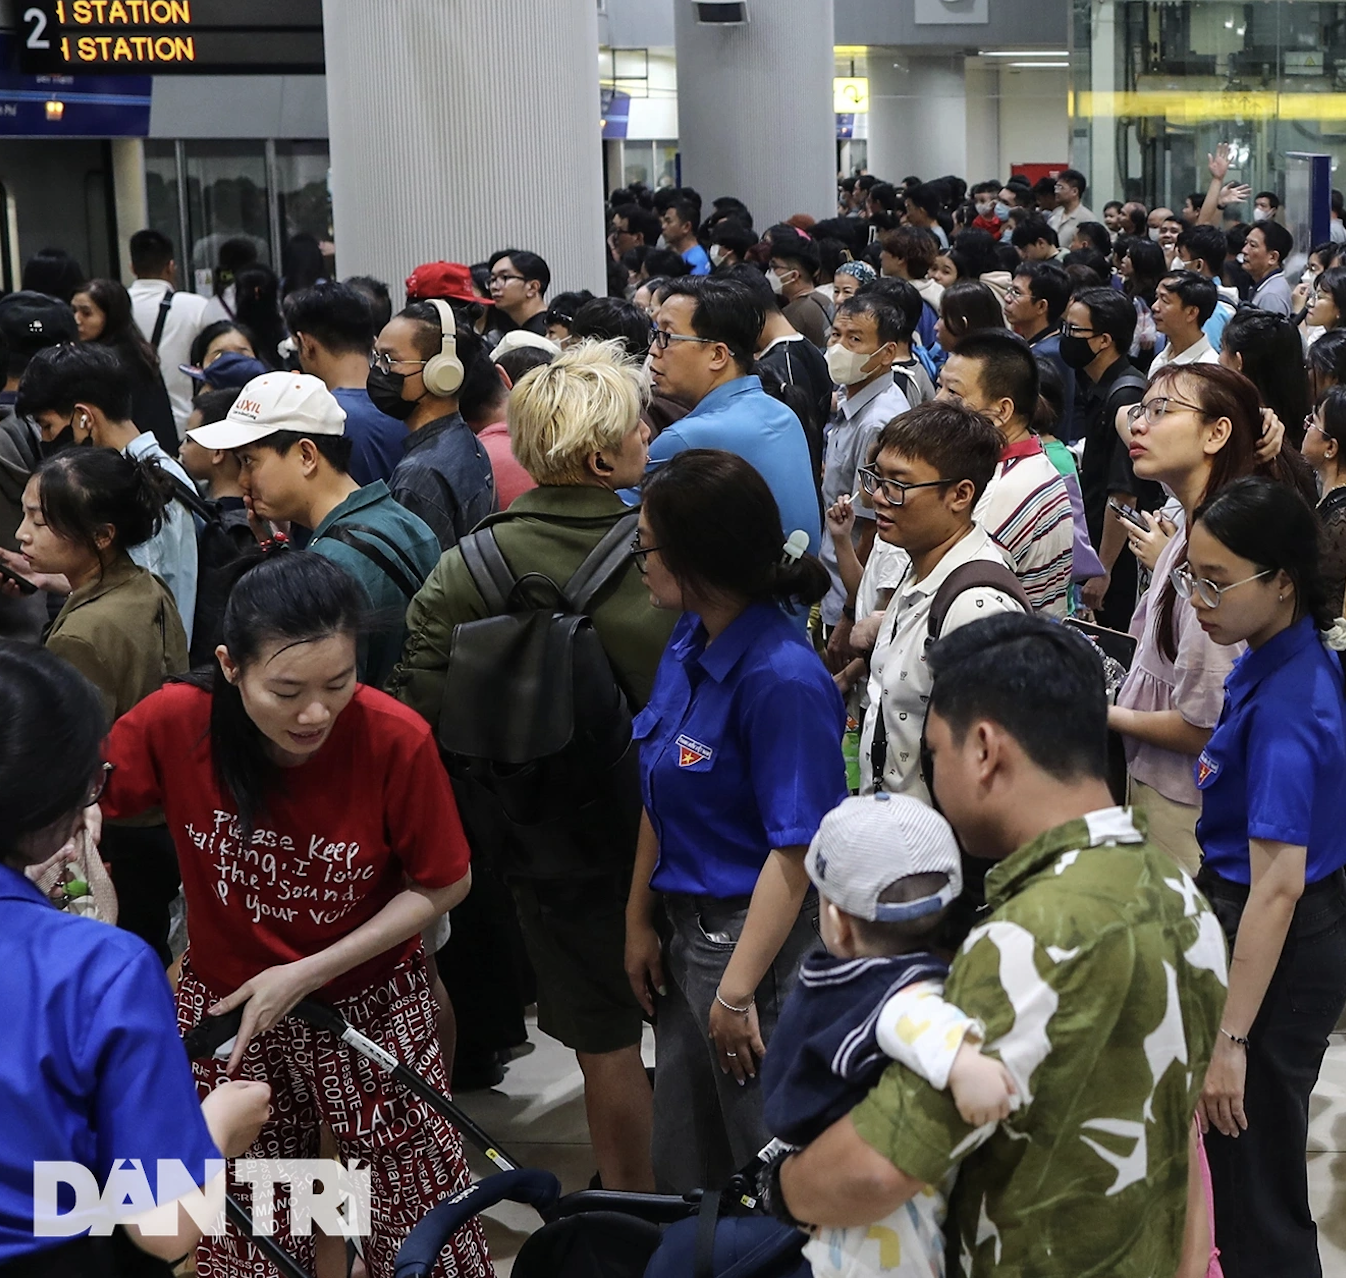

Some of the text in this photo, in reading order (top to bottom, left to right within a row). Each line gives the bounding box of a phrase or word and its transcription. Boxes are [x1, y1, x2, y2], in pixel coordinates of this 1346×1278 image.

[73, 0, 191, 24] STATION
[23, 7, 50, 49] 2
[77, 36, 195, 61] STATION
[236, 400, 261, 414] LIXIL
[213, 857, 261, 890] the
[245, 894, 299, 923] your
[392, 1012, 417, 1070] ROMAN
